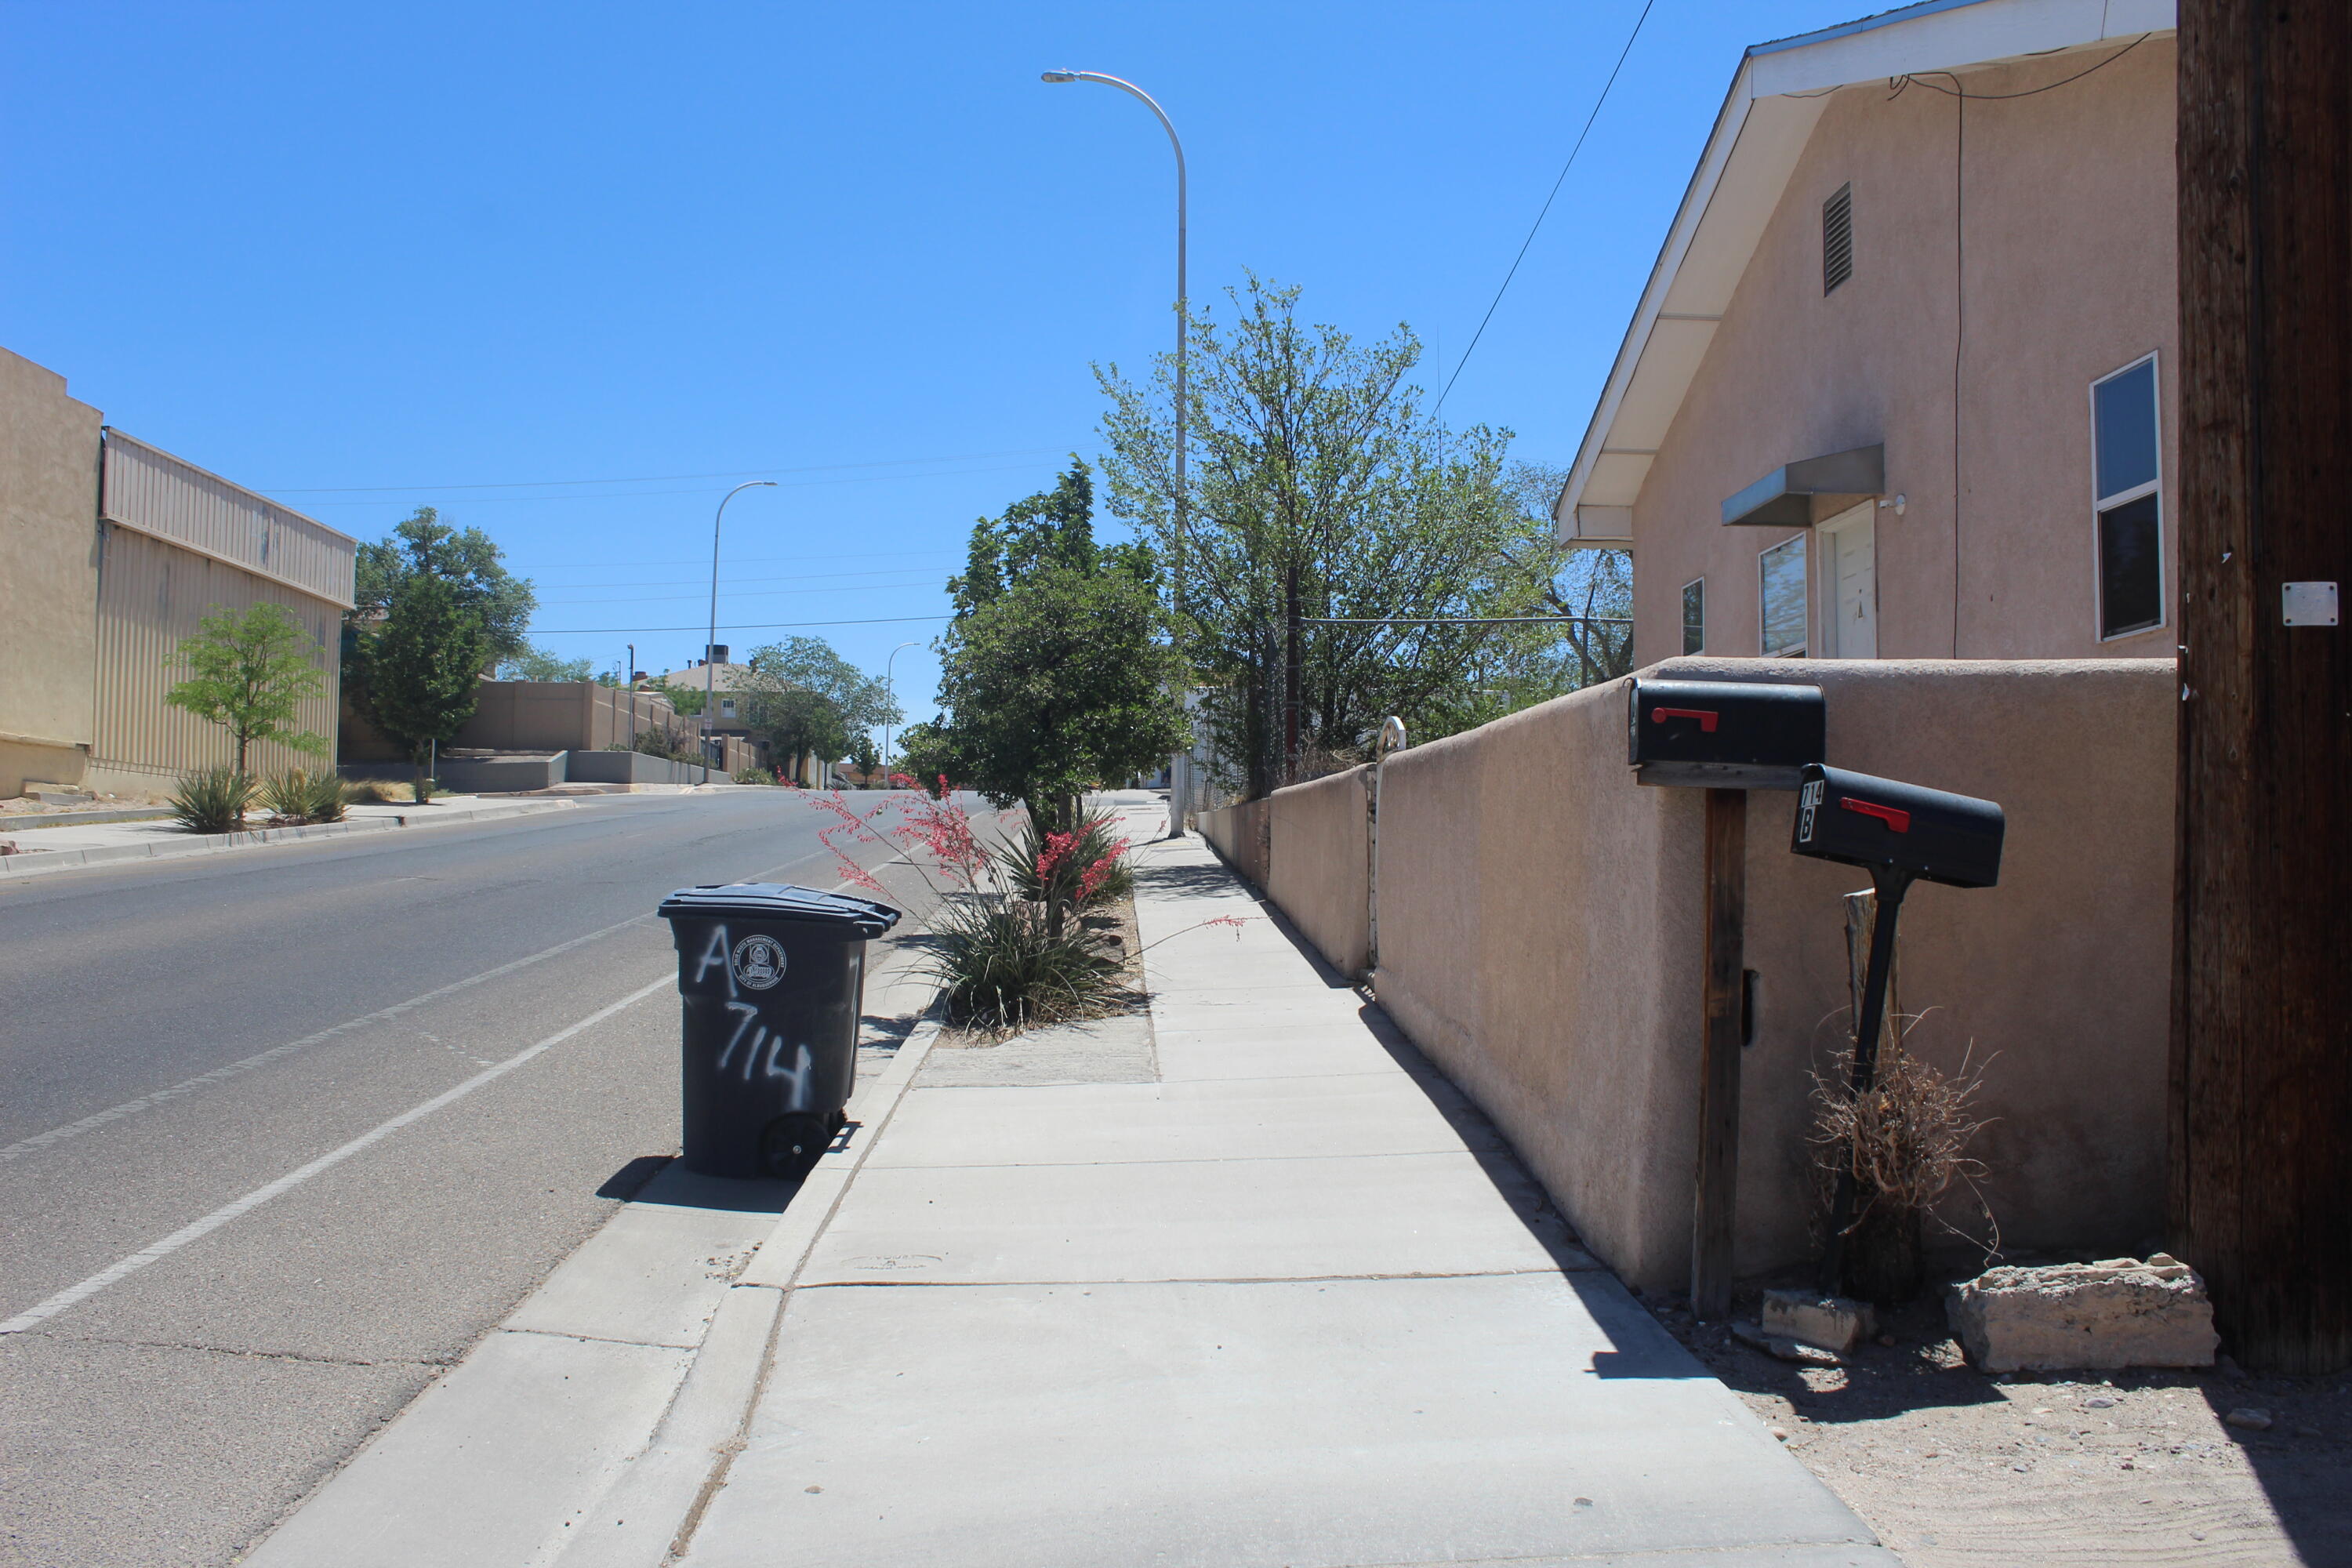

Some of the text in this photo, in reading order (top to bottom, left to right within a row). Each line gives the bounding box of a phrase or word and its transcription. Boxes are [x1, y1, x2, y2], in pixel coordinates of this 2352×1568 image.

[1803, 782, 1823, 807] 714
[1802, 808, 1813, 840] B
[695, 925, 739, 998] A
[772, 943, 784, 967] DEPARTMENT
[719, 1001, 811, 1110] 714
